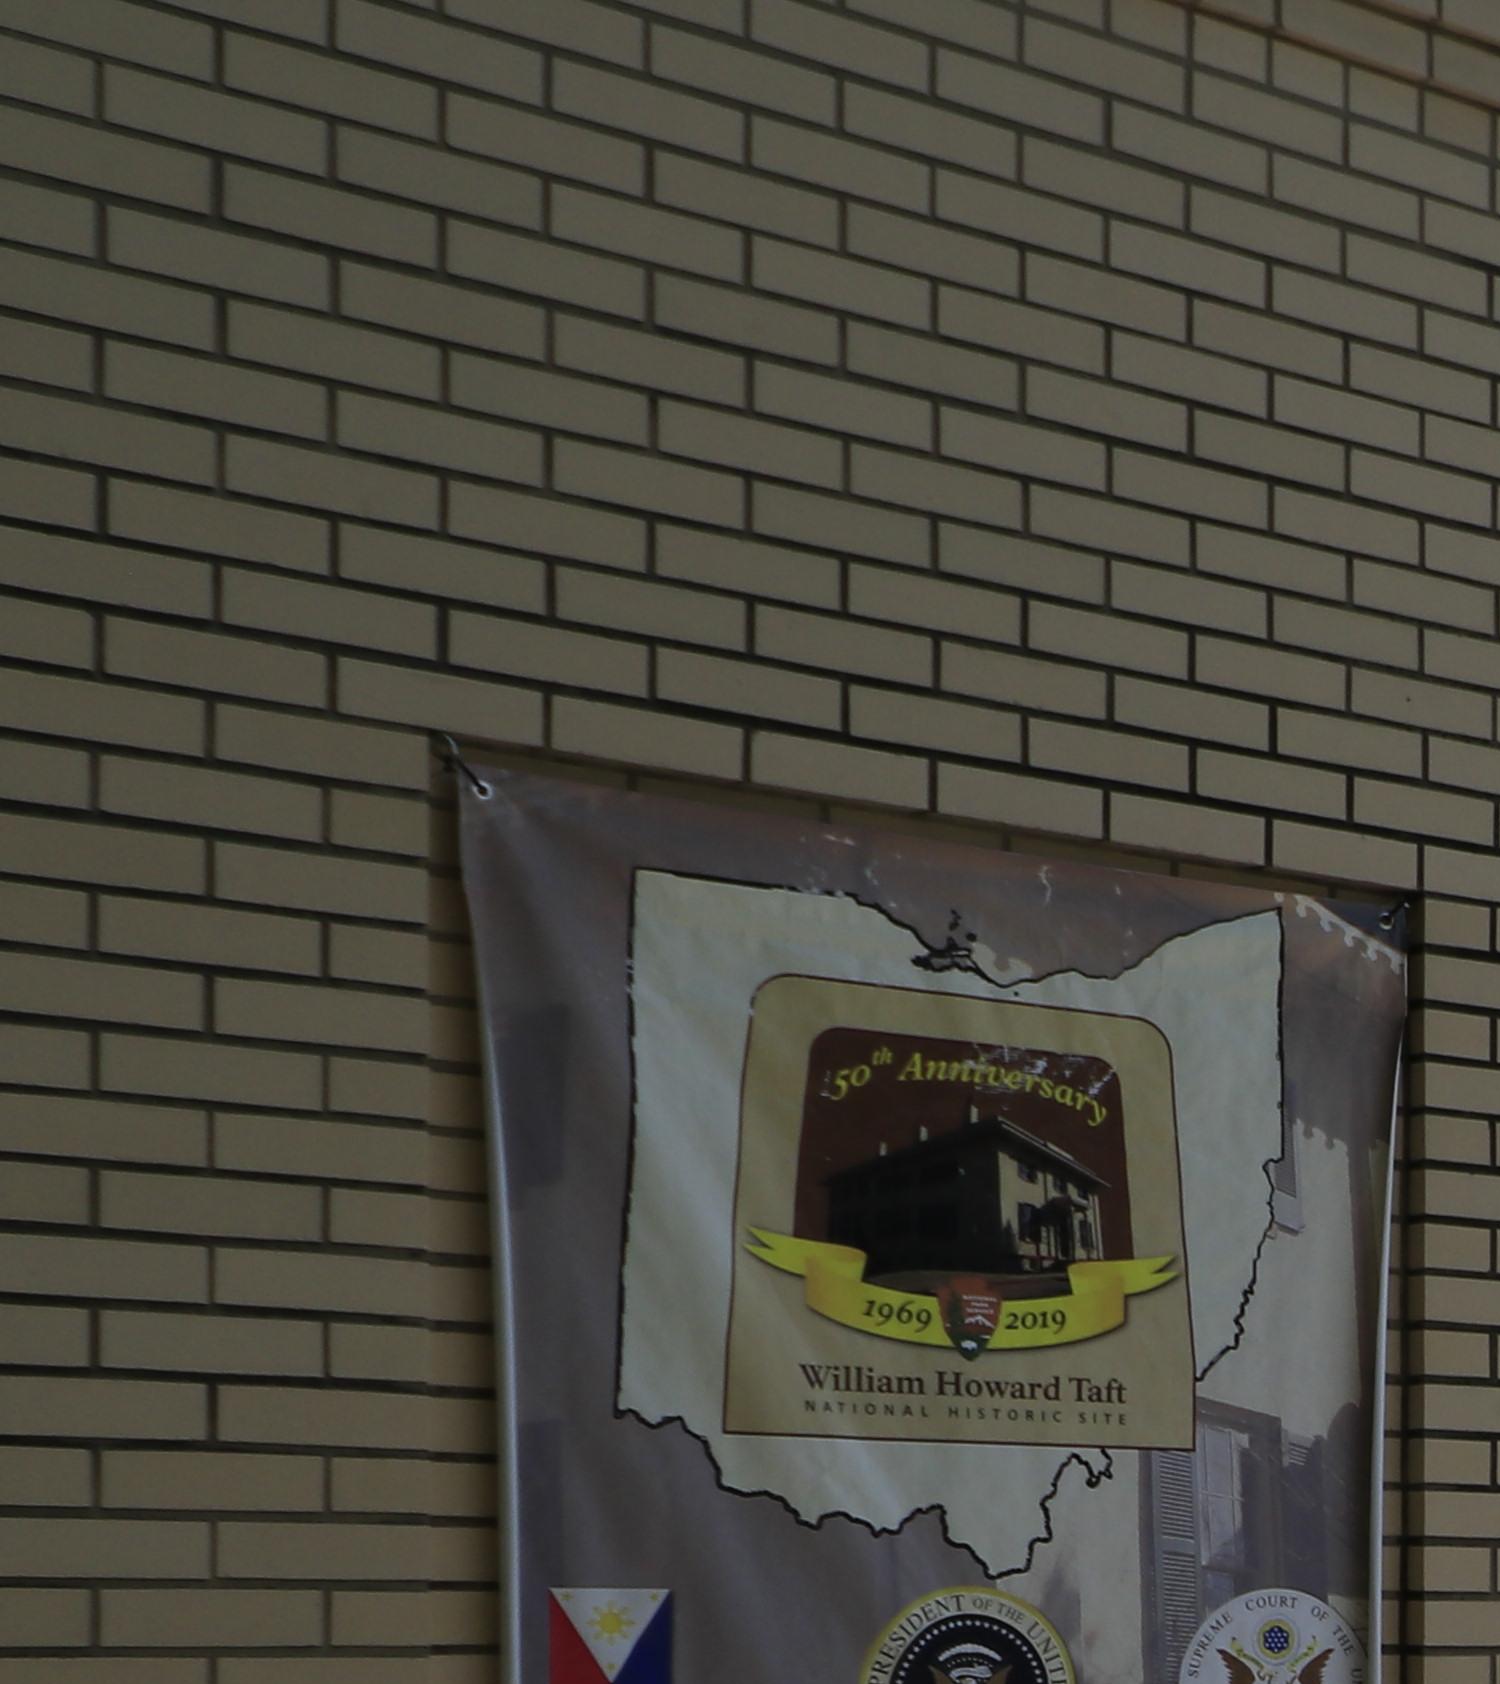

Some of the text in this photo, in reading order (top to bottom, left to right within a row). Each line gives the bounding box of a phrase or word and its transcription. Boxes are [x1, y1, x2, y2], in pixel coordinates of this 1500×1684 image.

[830, 1046, 1108, 1126] 50th Anniversary
[862, 1299, 932, 1334] 1969
[1004, 1309, 1066, 1334] 2019
[799, 1362, 1127, 1405] William Howard Taft
[804, 1400, 1127, 1426] NATIONAL HISTORIC SITE
[972, 1596, 992, 1611] OF
[996, 1602, 1027, 1625] THE
[1188, 1611, 1234, 1679] SUPREME
[1244, 1595, 1299, 1612] COURT
[1310, 1605, 1330, 1622] OF
[1332, 1625, 1355, 1657] THE
